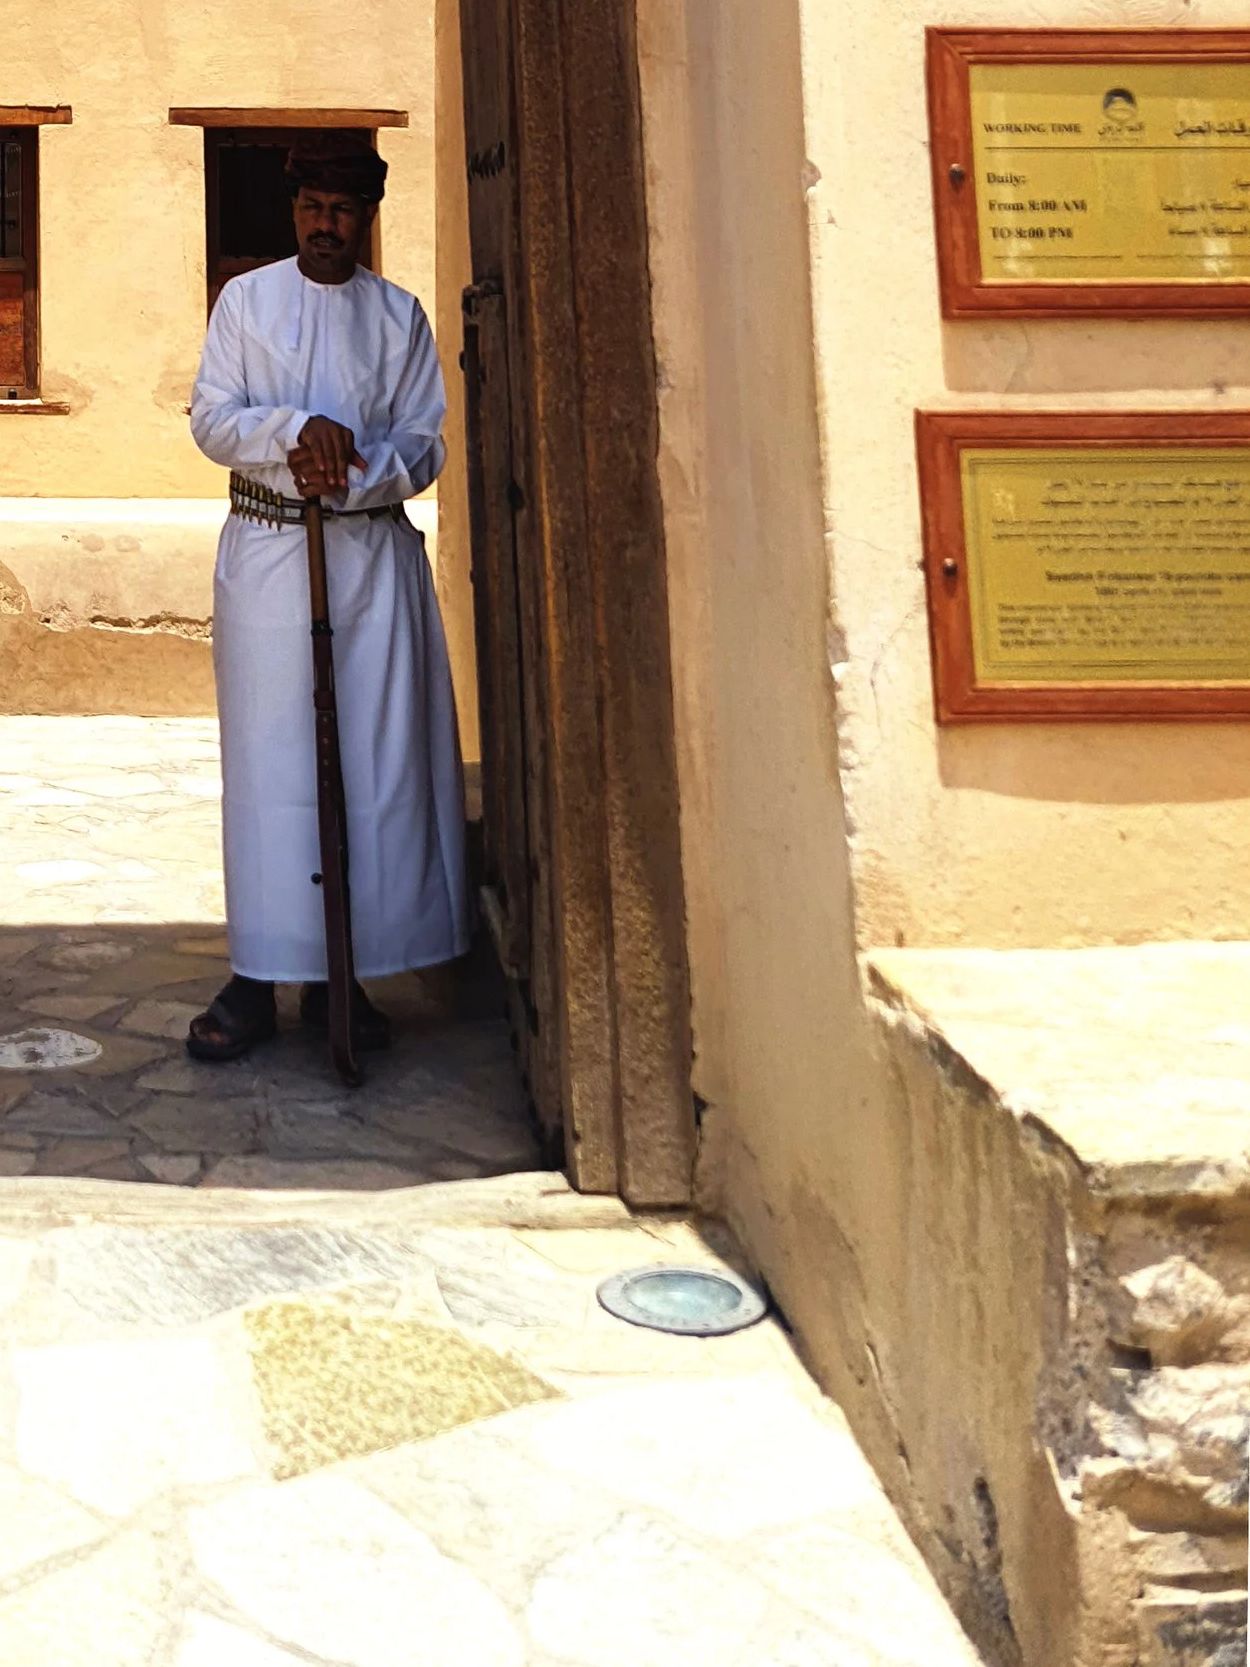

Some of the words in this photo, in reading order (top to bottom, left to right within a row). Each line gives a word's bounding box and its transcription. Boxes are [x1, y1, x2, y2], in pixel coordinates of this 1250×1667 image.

[983, 123, 1046, 133] WORKING
[1051, 123, 1082, 133] TIME
[988, 200, 1024, 211] From
[1063, 200, 1087, 212] AM
[992, 227, 1011, 238] TO
[1048, 227, 1073, 238] PM
